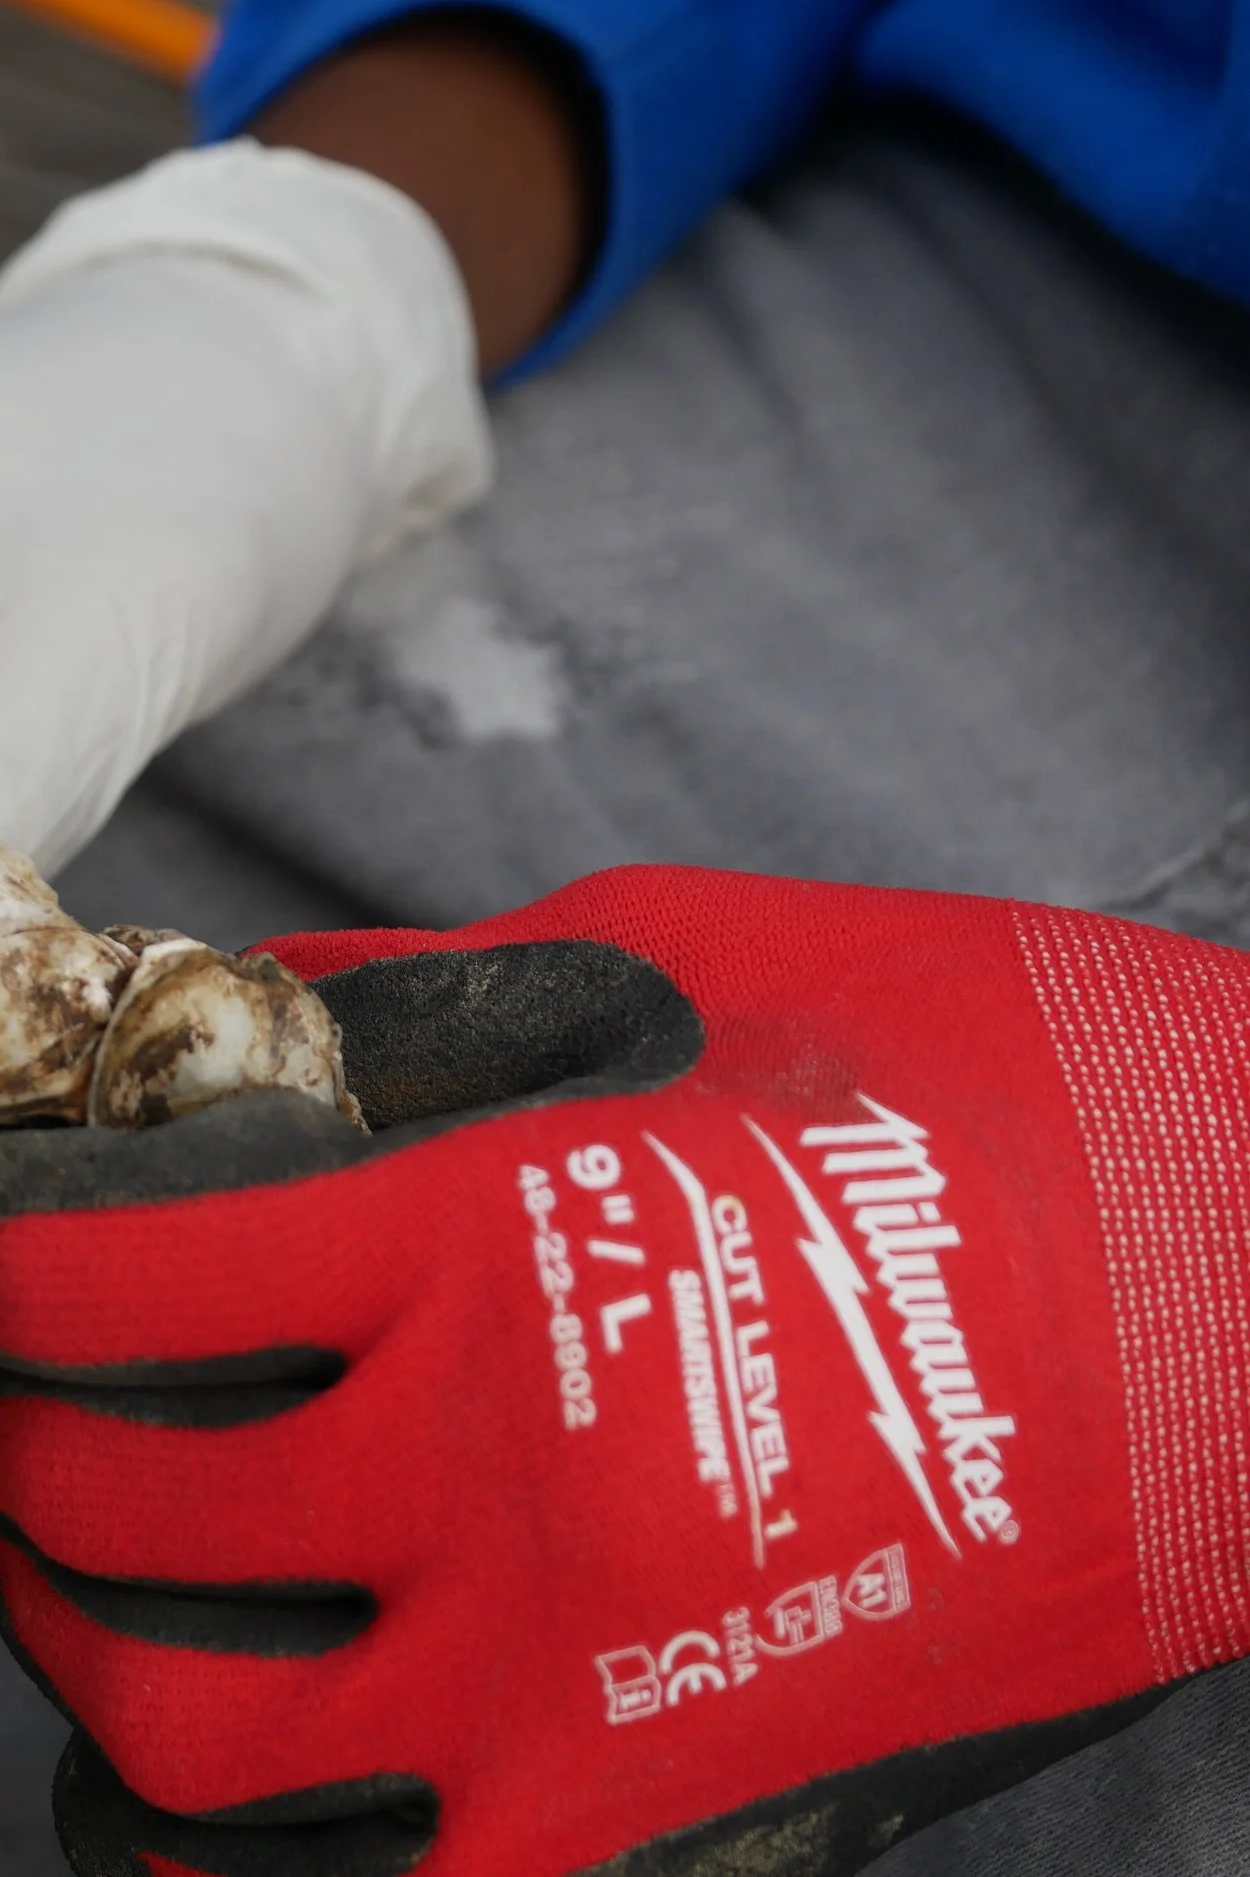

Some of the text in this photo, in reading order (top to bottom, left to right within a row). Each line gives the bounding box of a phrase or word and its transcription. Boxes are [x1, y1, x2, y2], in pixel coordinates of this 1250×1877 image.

[517, 1164, 597, 1430] 48-22-8902
[600, 1293, 652, 1354] L
[711, 1195, 798, 1539] CUT LEVEL 1
[855, 1573, 888, 1609] A1
